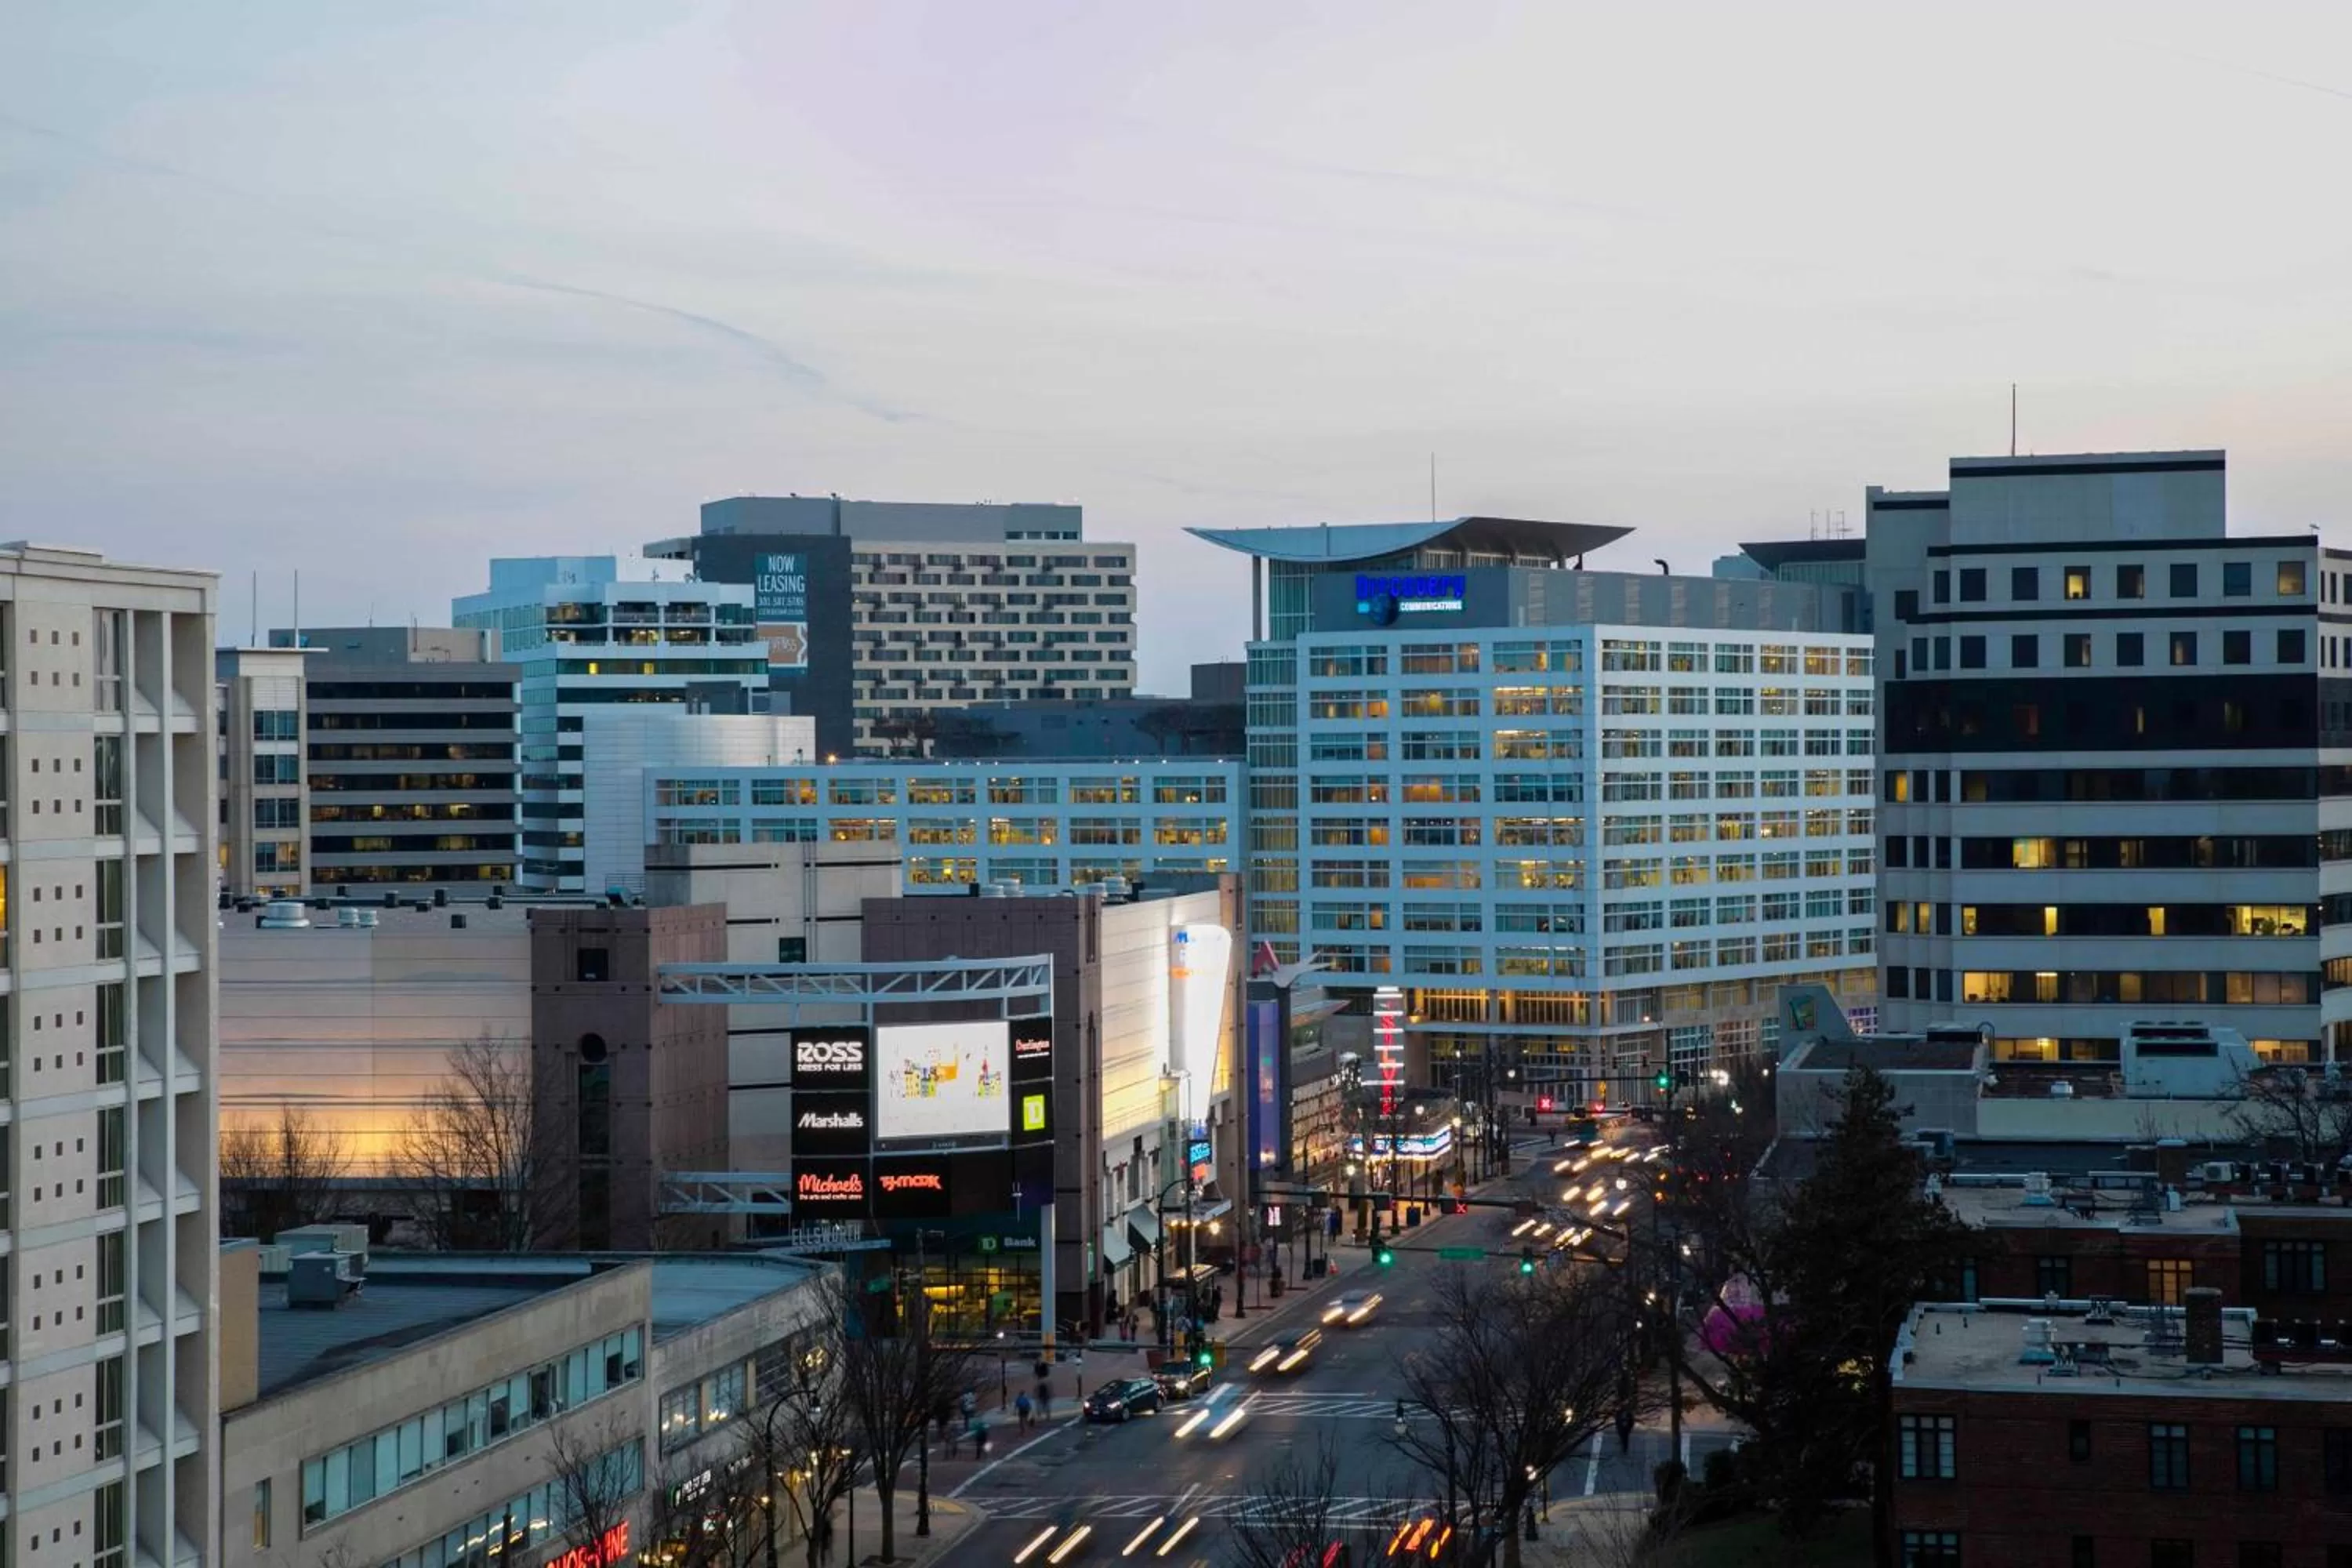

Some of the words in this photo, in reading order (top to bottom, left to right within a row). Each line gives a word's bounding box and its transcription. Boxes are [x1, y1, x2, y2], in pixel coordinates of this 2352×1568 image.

[768, 555, 794, 572] NOW
[757, 575, 805, 593] LEASING
[797, 1041, 863, 1062] ROSS
[797, 1112, 864, 1129] Marshalls
[798, 1173, 863, 1192] Michaels
[791, 1223, 861, 1246] ELLSWORTH
[1004, 1236, 1036, 1247] Bank
